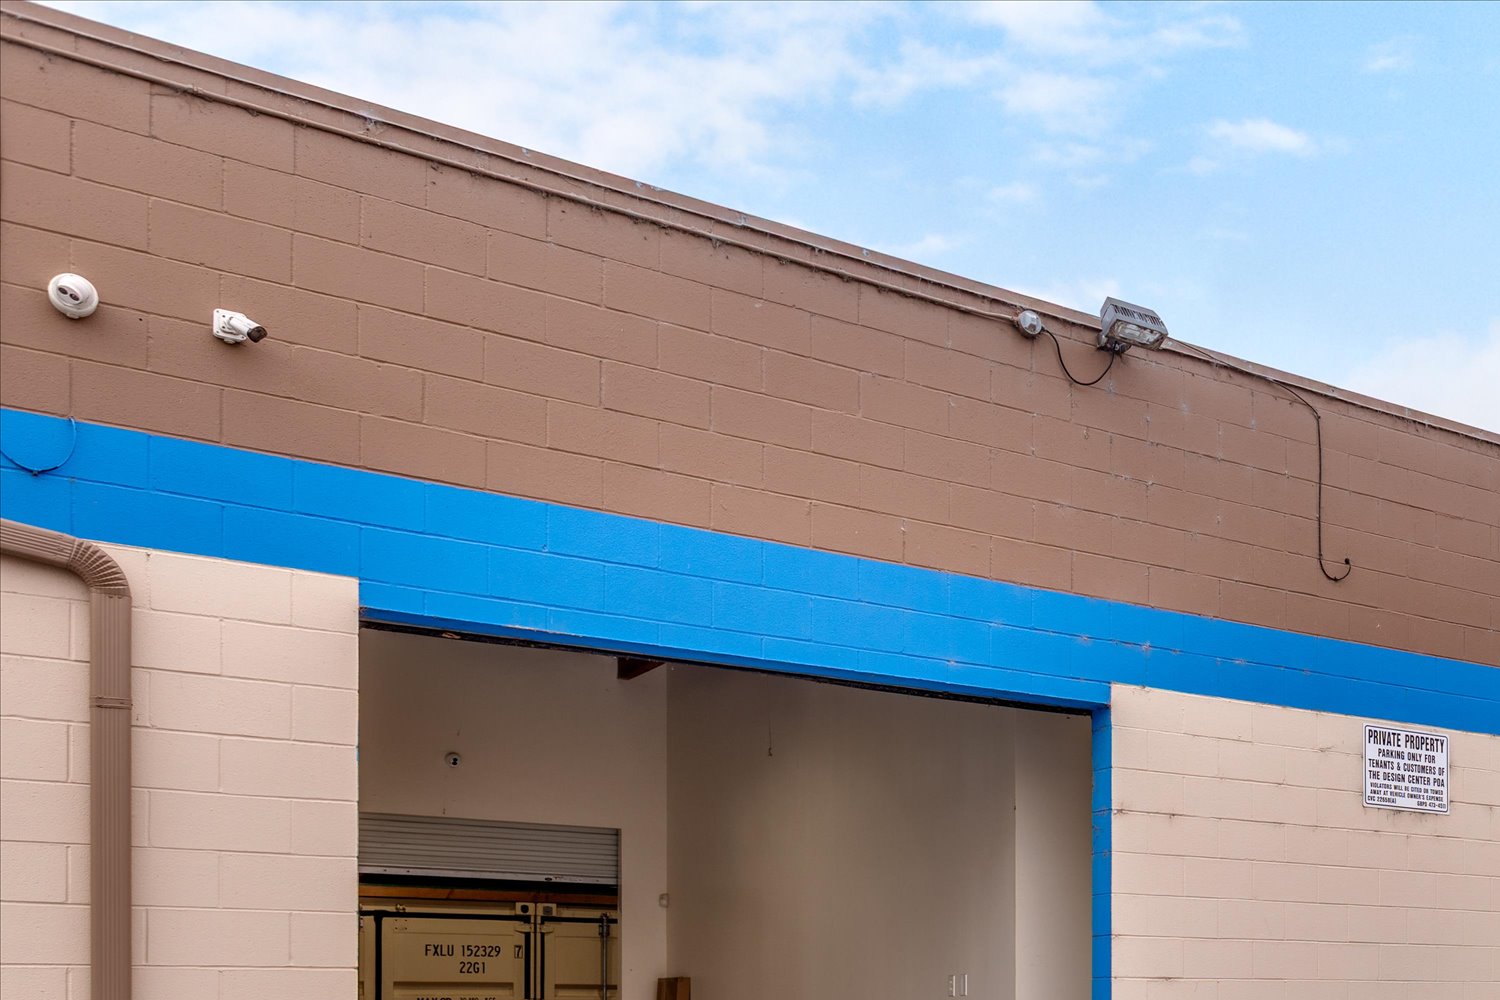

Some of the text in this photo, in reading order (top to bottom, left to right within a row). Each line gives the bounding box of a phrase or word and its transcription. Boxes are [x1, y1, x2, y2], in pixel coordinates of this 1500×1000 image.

[1368, 729, 1445, 753] PRIVATE PROPERTY
[1378, 748, 1436, 764] PARKING ONLY FOR
[1368, 758, 1445, 776] TENANTS & CUSTOMERS OF
[1368, 770, 1445, 788] THE DESIGN CENTER POA
[1370, 782, 1392, 790] VIOLATORS
[1426, 795, 1444, 803] EXPENSE
[424, 944, 522, 958] FXLU 152329 7
[459, 961, 486, 974] 22G1
